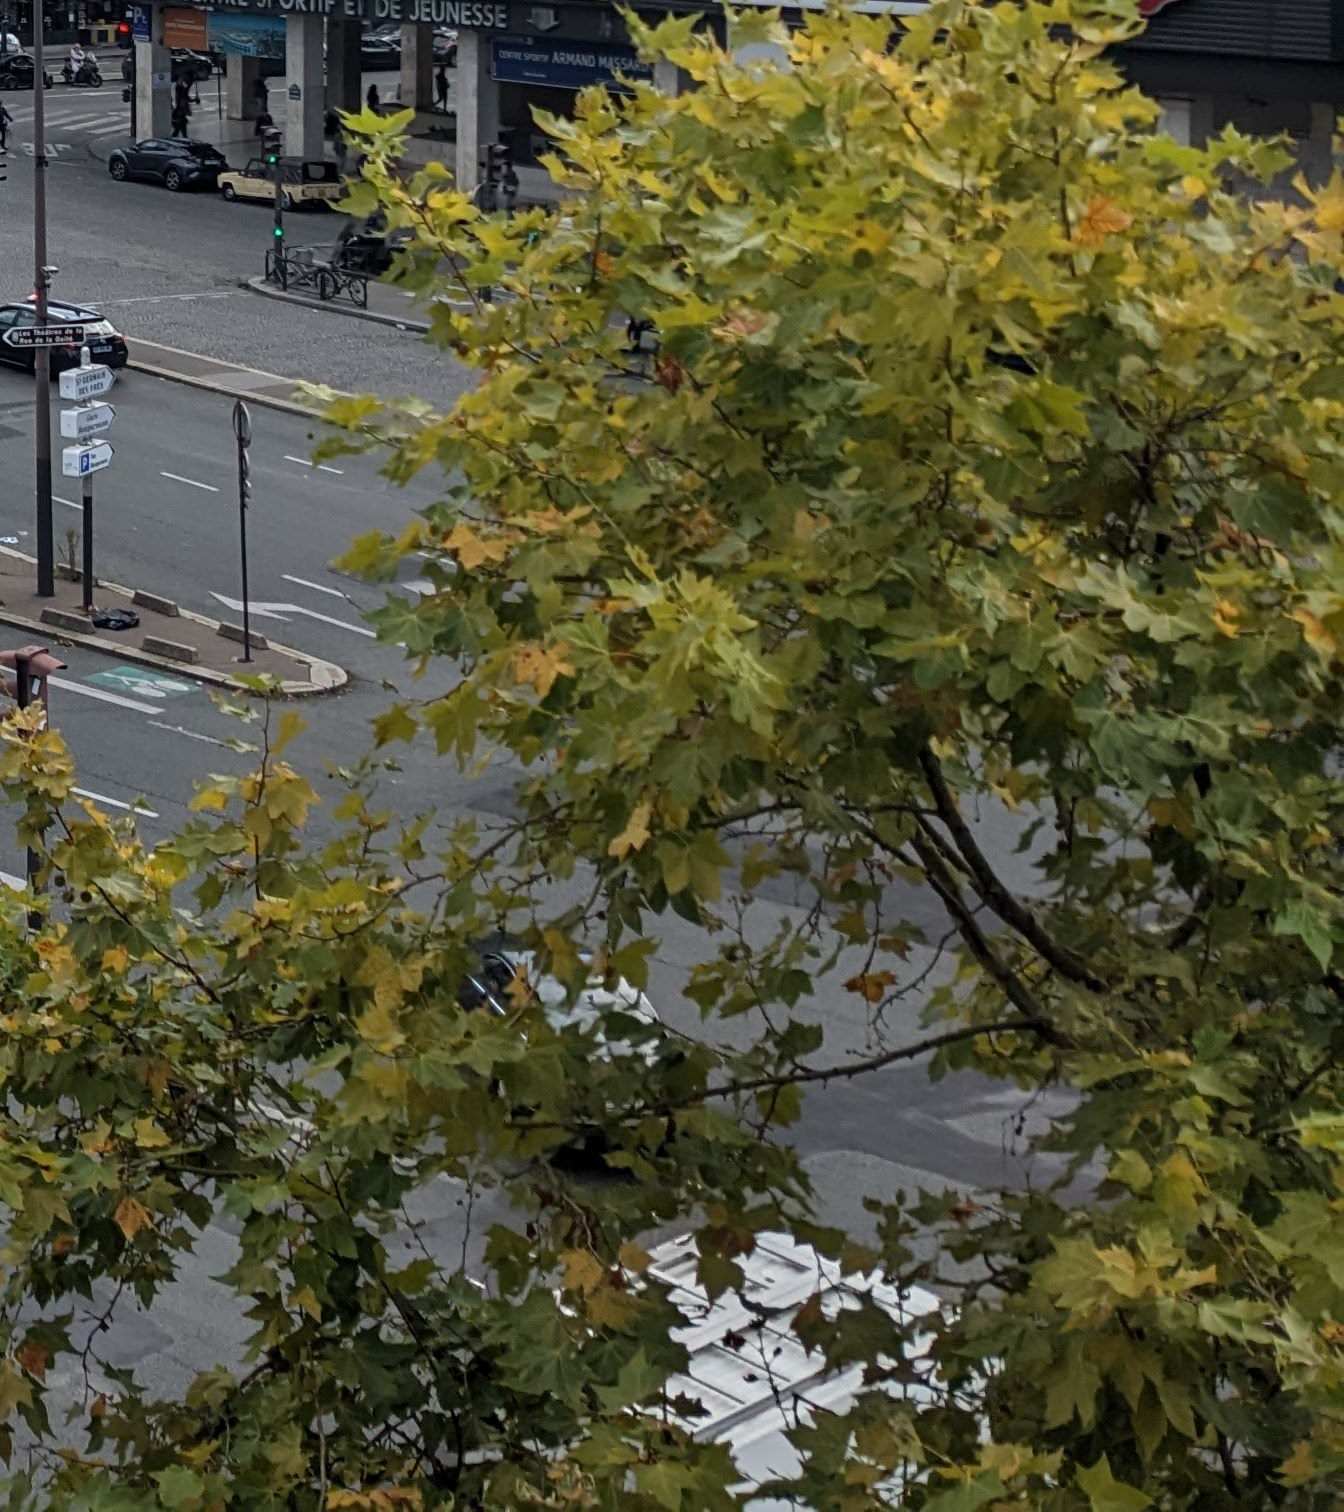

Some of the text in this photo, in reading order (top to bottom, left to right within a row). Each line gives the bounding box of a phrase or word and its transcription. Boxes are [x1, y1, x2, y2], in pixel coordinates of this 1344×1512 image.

[551, 51, 596, 68] ARMAND
[82, 371, 106, 385] GERMAIN
[78, 385, 89, 396] DES
